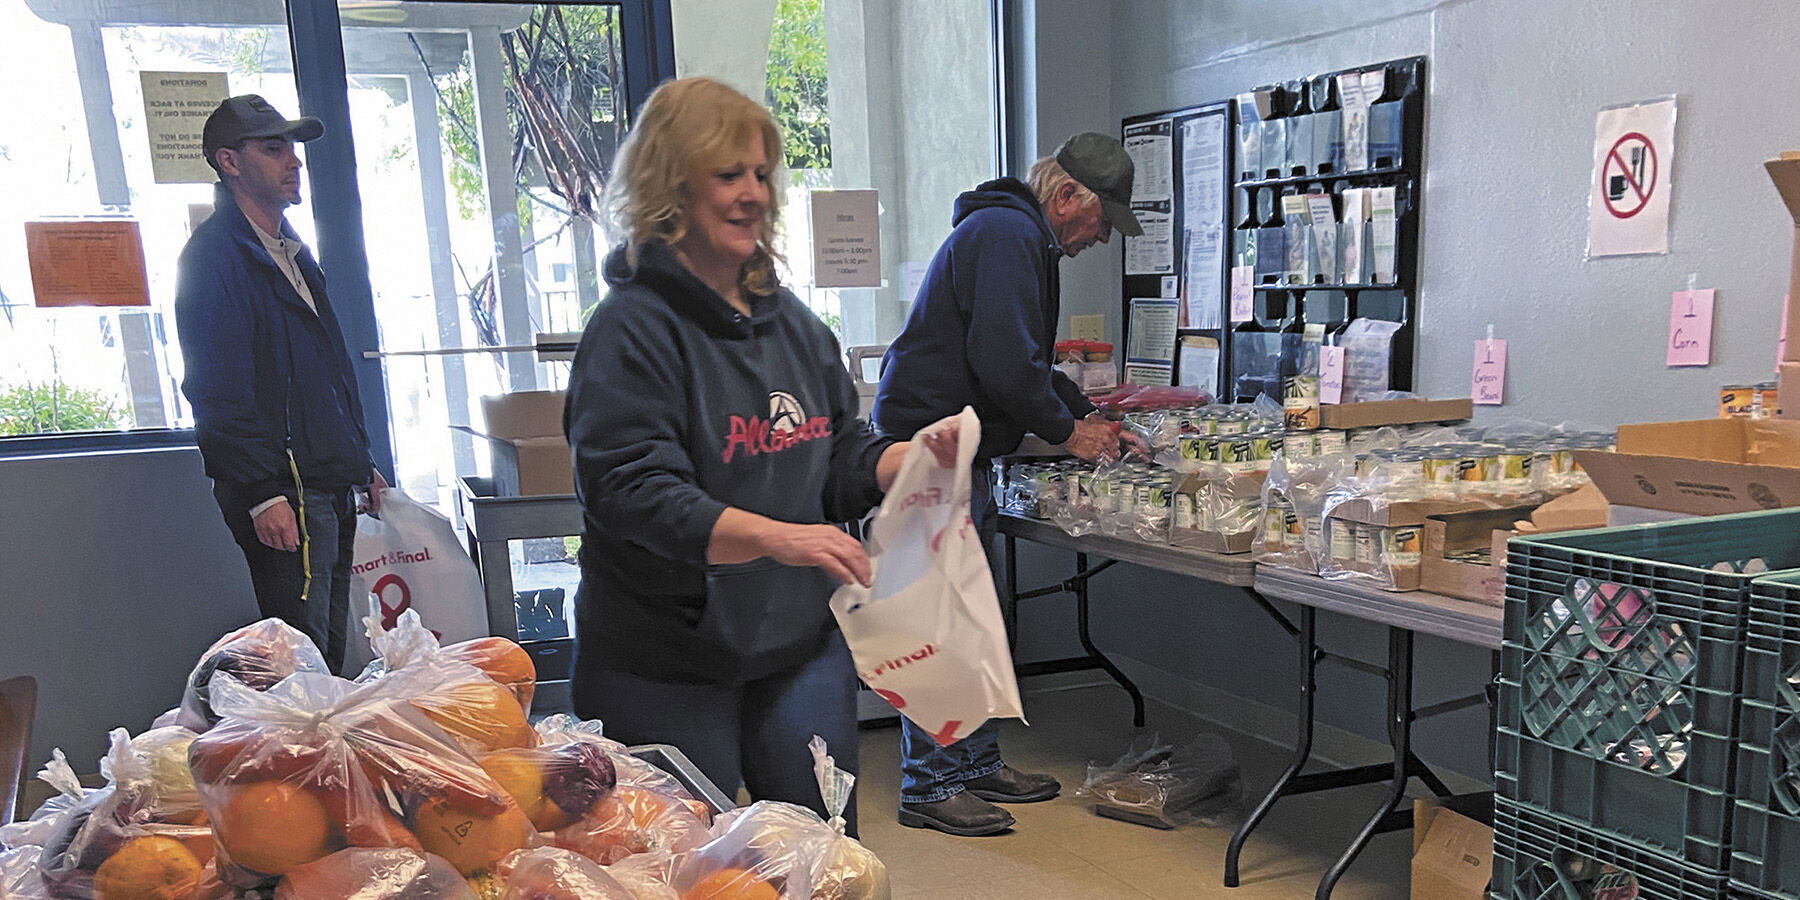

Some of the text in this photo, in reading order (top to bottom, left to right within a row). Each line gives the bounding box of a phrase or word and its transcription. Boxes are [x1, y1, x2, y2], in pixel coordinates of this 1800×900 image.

[1673, 328, 1699, 350] Corn
[1474, 368, 1498, 384] Green
[1727, 404, 1753, 414] BLAC
[351, 546, 430, 575] mart&Final
